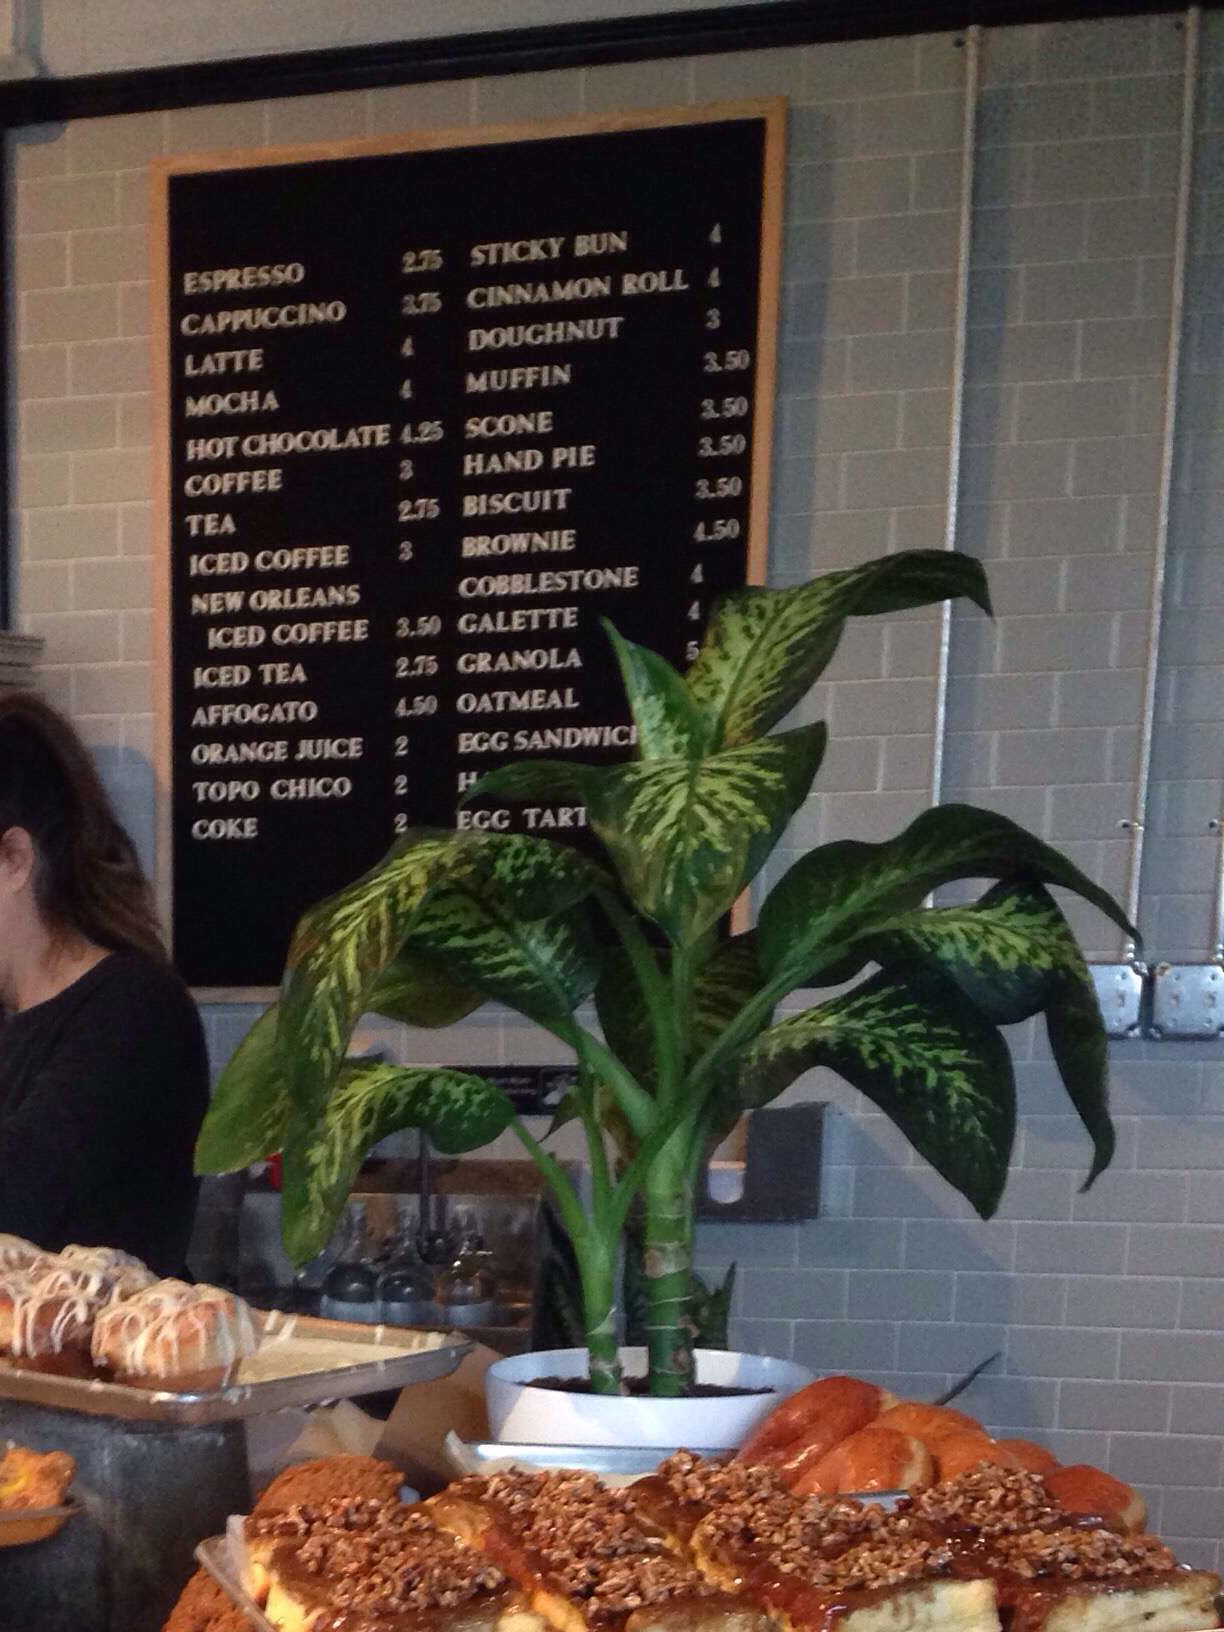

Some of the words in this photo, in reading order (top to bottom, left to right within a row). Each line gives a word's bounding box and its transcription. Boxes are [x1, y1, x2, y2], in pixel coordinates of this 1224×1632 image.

[470, 237, 565, 268] STICKY
[574, 231, 628, 257] BUN
[708, 223, 722, 243] 4
[183, 263, 305, 295] ESPRESSO
[467, 276, 611, 310] CINNAMON
[622, 269, 690, 296] ROLL
[707, 268, 720, 288] 4
[181, 301, 347, 336] CAPPUCCINO
[469, 317, 624, 351] DOUGHNUT
[705, 308, 721, 330] 3
[185, 349, 264, 376] LATTE
[401, 336, 414, 357] 4
[466, 364, 572, 393] MUFFIN
[703, 349, 751, 373] 3.50
[185, 390, 279, 417] MOCHA
[400, 379, 413, 399] 4
[465, 411, 553, 439] SCONE
[700, 396, 749, 420] 3.50
[186, 436, 239, 460] HOT
[242, 424, 391, 457] CHOCOLATE
[463, 449, 543, 476] HAND
[552, 445, 596, 469] PIE
[698, 434, 747, 457] 3.50
[184, 469, 283, 497] COFFEE
[399, 459, 413, 481] 3
[463, 488, 572, 517] BISCUIT
[696, 476, 742, 500] 3.50
[185, 514, 237, 537] TEA
[398, 499, 440, 522] 2.75
[462, 530, 576, 558] BROWNIE
[693, 519, 740, 542] 4.50
[189, 552, 249, 576] ICED
[254, 545, 350, 572] COFFEE
[399, 541, 413, 561] 3
[458, 566, 639, 598] COBBLESTONE
[690, 563, 703, 584] 4
[191, 591, 245, 615] NEW
[249, 584, 360, 611] ORLEANS
[208, 625, 266, 650] ICED
[272, 619, 369, 645] COFFEE
[396, 616, 442, 638] 3.50
[458, 607, 579, 634] GALETTE
[688, 601, 700, 621] 4
[194, 665, 251, 689] ICED
[259, 663, 308, 685] TEA
[395, 655, 439, 678] 2.75
[457, 648, 583, 674] GRANOLA
[685, 641, 699, 661] 5
[192, 701, 318, 727] AFFOGATO
[395, 696, 438, 718] 4.50
[456, 688, 580, 714] OATMEAL
[191, 740, 288, 765] ORANGE
[294, 737, 364, 761] JUICE
[395, 735, 408, 757] 2
[458, 730, 508, 754] EGG
[192, 780, 260, 802] TOPO
[270, 776, 352, 800] CHICO
[394, 775, 408, 795] 2
[192, 817, 258, 840] COKE
[394, 813, 408, 833] 2
[456, 810, 510, 830] EGG
